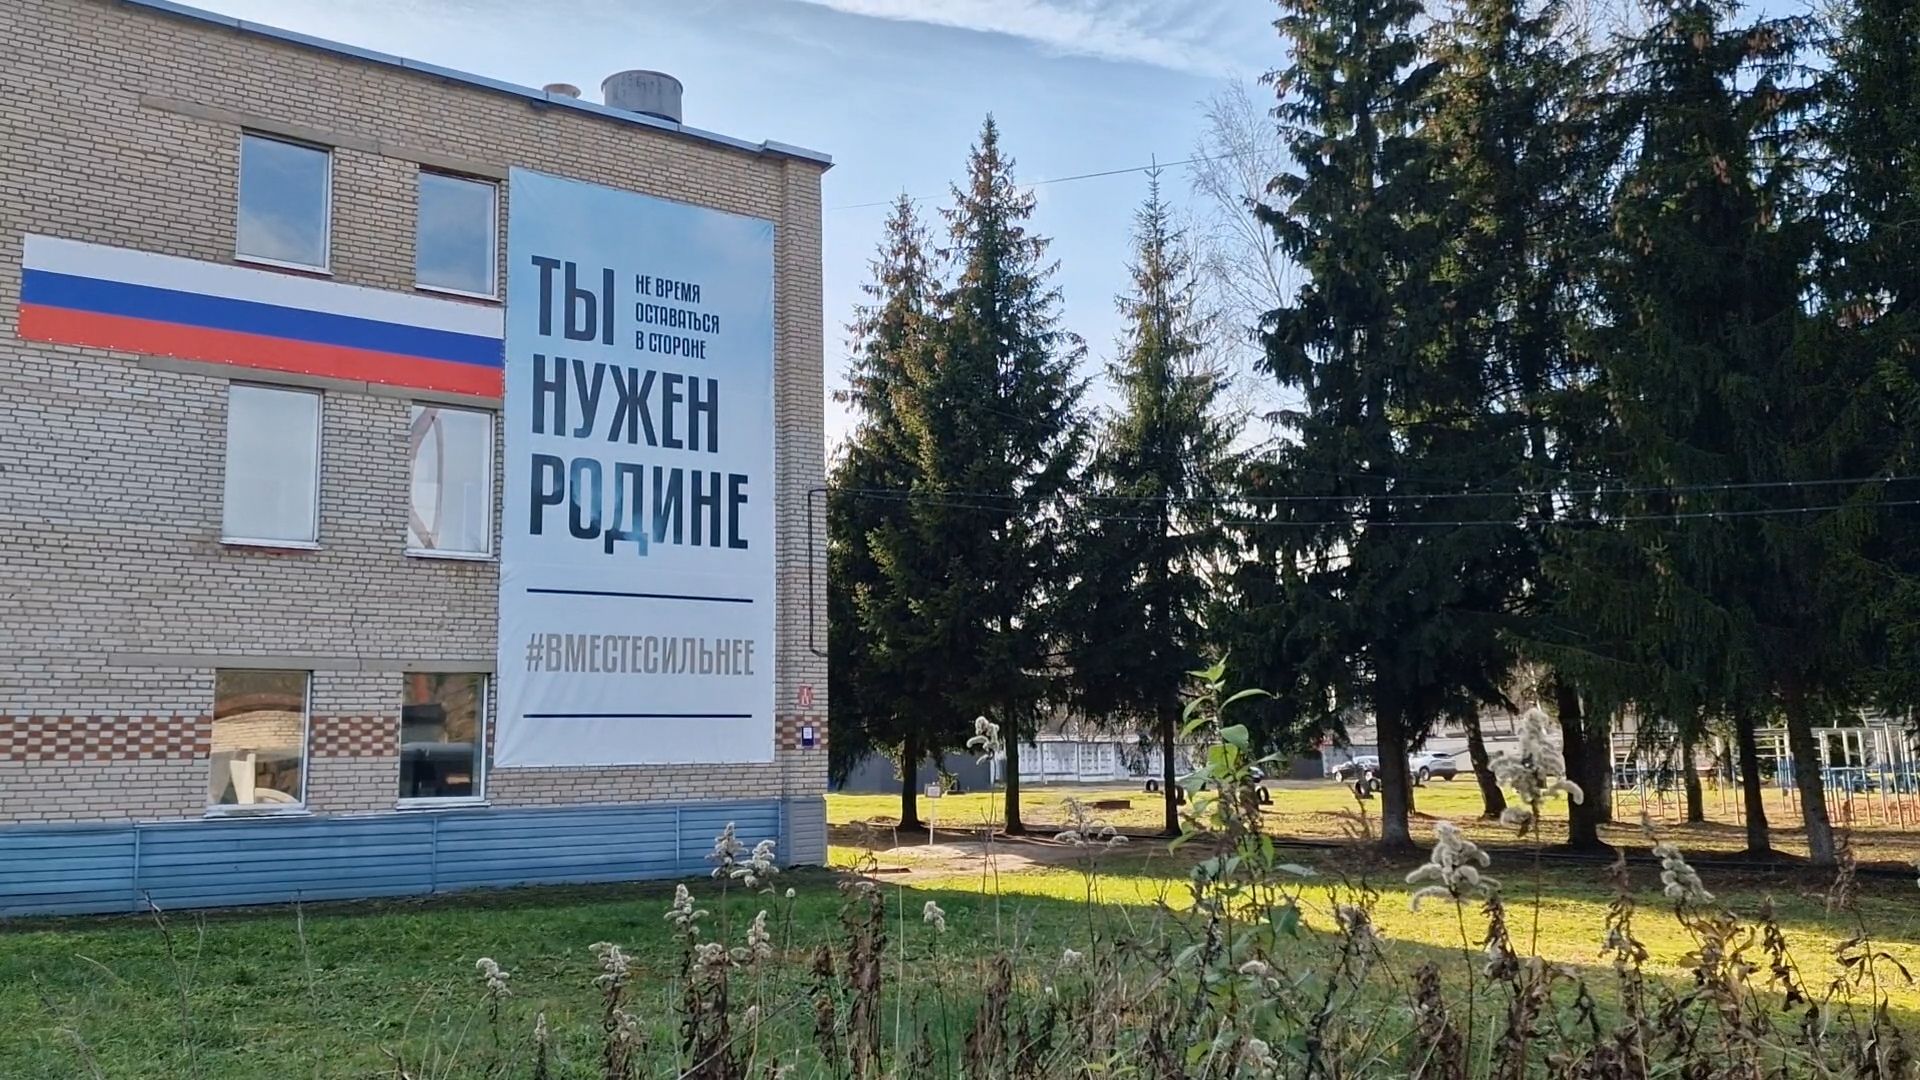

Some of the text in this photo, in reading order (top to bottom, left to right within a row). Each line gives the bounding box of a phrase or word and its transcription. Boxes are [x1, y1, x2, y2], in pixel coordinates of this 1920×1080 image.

[531, 255, 615, 345] ТЫ
[635, 274, 701, 303] НЕ ВРЕМЯ
[635, 302, 720, 334] ОСТАВАТЬСЯ
[635, 331, 706, 359] В СТОРОНЕ
[532, 353, 719, 453] НУЖЕН
[529, 453, 749, 556] РОДИНЕ
[526, 633, 754, 675] #ВМЕСТЕСИЛЬНЕЕ
